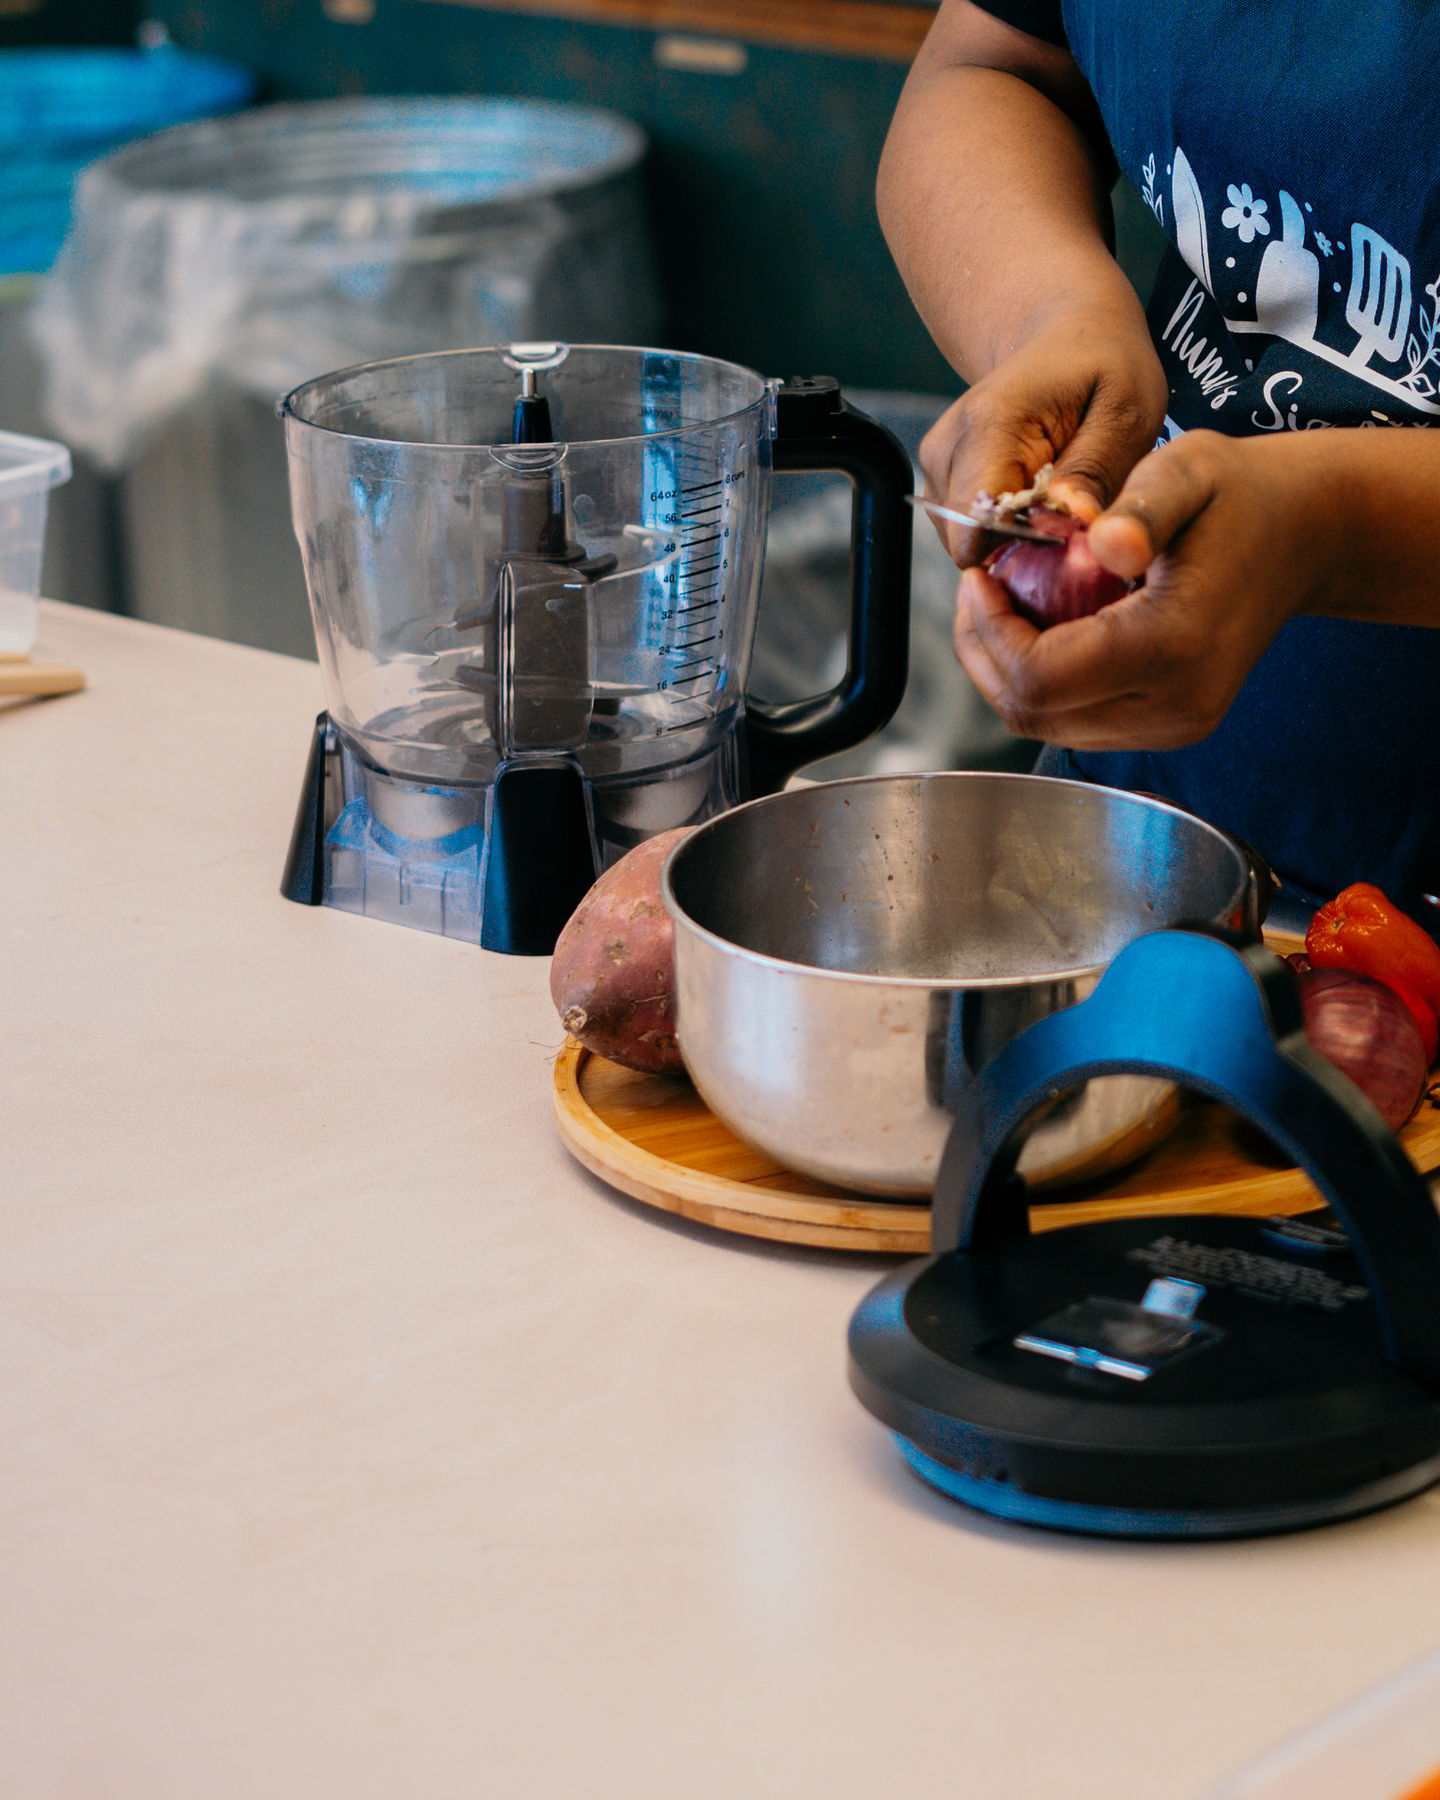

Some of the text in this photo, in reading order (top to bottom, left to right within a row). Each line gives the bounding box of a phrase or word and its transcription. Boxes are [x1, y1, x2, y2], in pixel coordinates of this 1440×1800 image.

[665, 512, 678, 523] 56
[724, 527, 730, 538] 6
[664, 542, 676, 553] 48
[722, 559, 728, 569] 5
[663, 573, 675, 584] 40
[661, 609, 673, 621] 32
[658, 644, 671, 656] 24
[656, 680, 668, 691] 16
